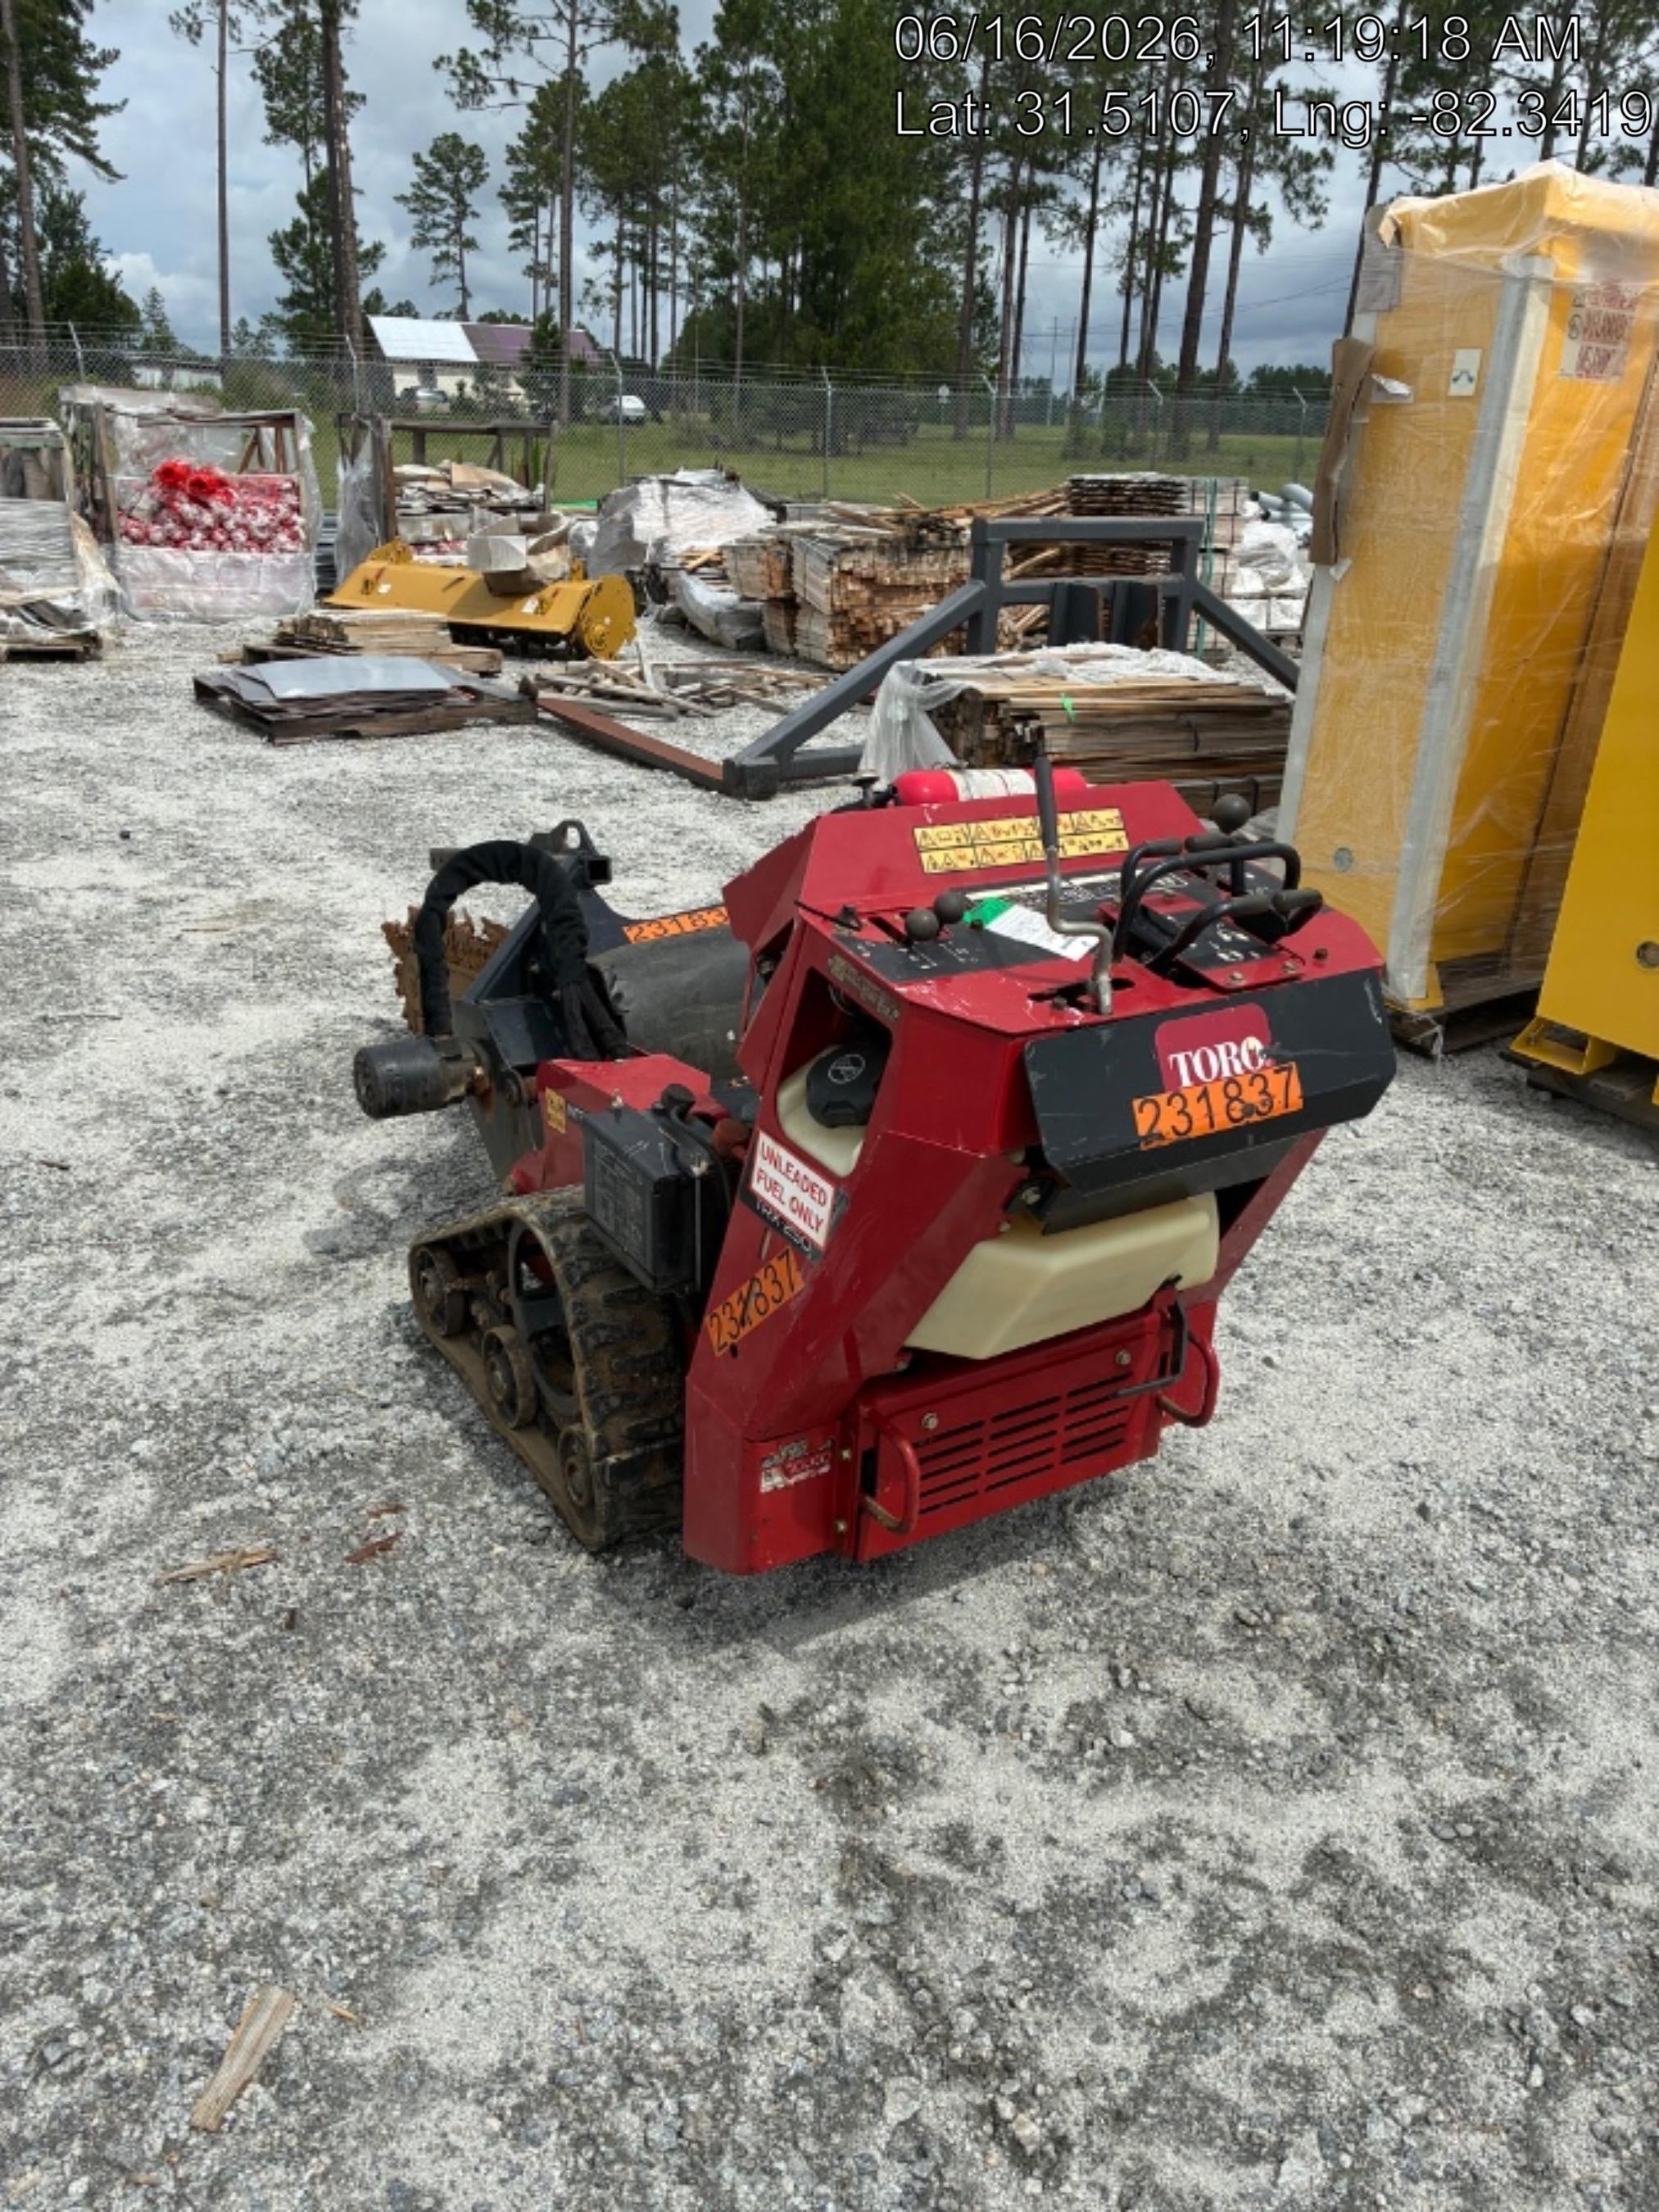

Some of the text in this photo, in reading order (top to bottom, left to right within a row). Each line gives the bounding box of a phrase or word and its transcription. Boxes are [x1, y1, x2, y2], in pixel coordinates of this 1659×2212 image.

[626, 907, 729, 941] 23183
[1167, 1036, 1267, 1088] TORO
[1136, 1063, 1294, 1145] 231837
[756, 1167, 824, 1232] FUEL ONLY
[761, 1141, 827, 1208] UNLEADED
[709, 1248, 795, 1353] 231837
